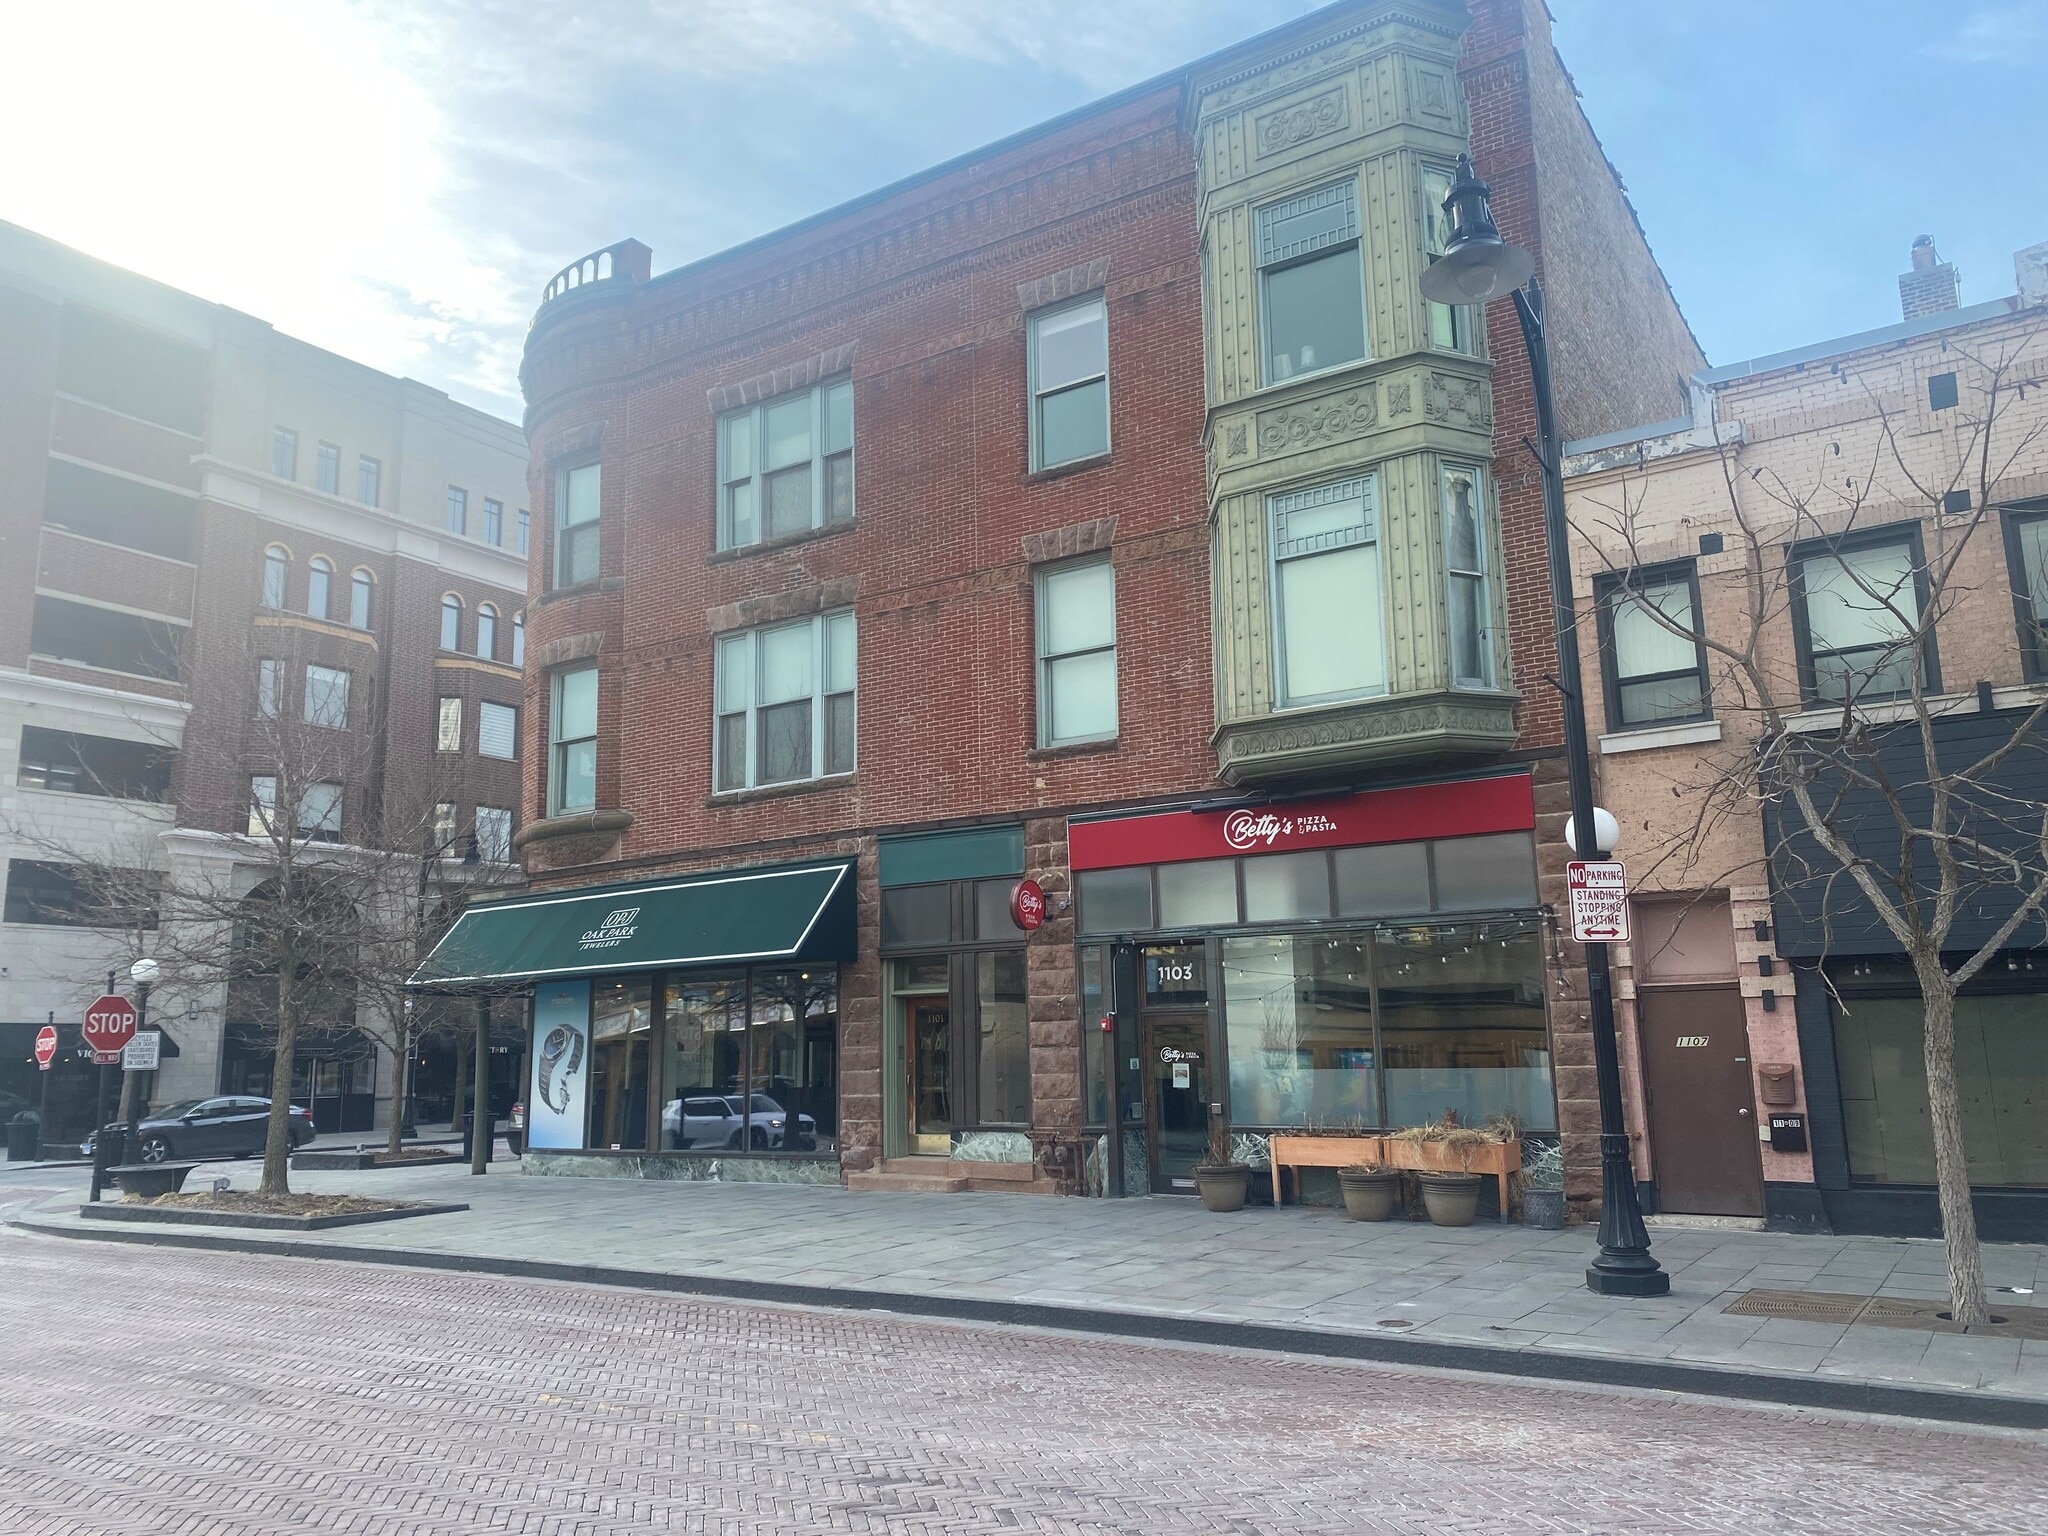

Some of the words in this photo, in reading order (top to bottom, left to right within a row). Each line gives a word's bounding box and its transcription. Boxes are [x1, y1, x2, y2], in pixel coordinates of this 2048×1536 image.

[1297, 815, 1328, 825] PIZZA
[1225, 809, 1293, 848] Betty's
[1305, 822, 1337, 833] PASTA
[1570, 868, 1585, 883] NO
[1586, 870, 1622, 881] PARKING
[1020, 891, 1042, 912] Betty's
[1577, 890, 1621, 901] STANDING
[1578, 902, 1622, 913] STOPPING
[1581, 914, 1621, 926] ANYTIME
[582, 930, 608, 940] OAK
[605, 926, 639, 938] PARK
[579, 940, 621, 951] JEWELERS
[1158, 966, 1193, 981] 1103
[87, 1012, 134, 1034] STOP
[928, 1014, 945, 1023] 1101
[37, 1037, 56, 1052] STOP
[1679, 1037, 1708, 1046] 1107
[96, 1054, 106, 1062] ALL
[107, 1053, 119, 1061] WAY
[1161, 1047, 1184, 1062] Betty's
